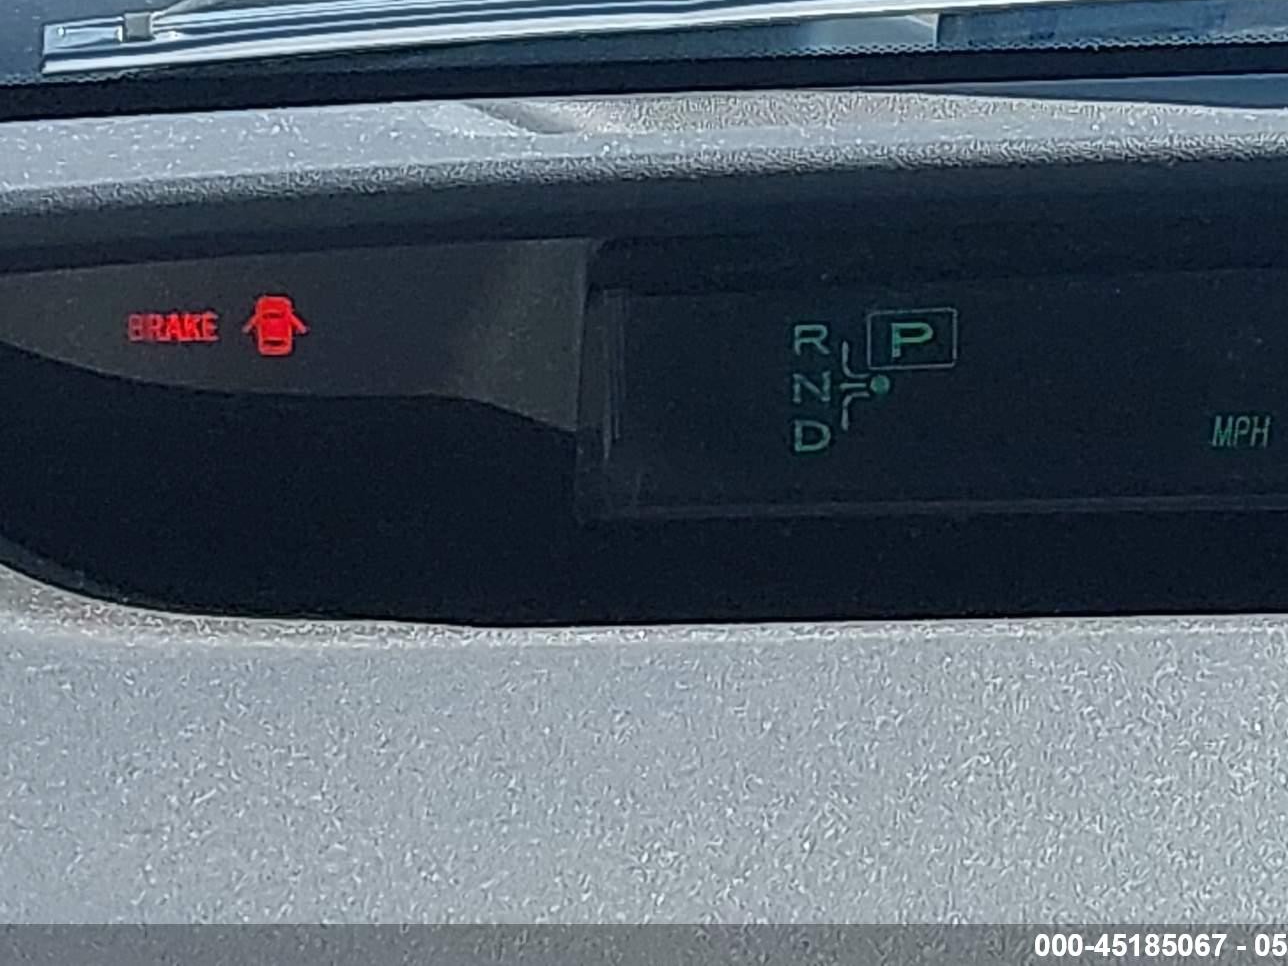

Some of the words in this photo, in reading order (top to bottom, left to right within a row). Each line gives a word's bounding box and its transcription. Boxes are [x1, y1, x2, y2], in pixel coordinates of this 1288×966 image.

[127, 311, 219, 341] BRAKE
[794, 324, 830, 355] R
[891, 322, 933, 358] P
[793, 371, 831, 403] N
[794, 420, 831, 452] D
[1211, 416, 1271, 447] MPH
